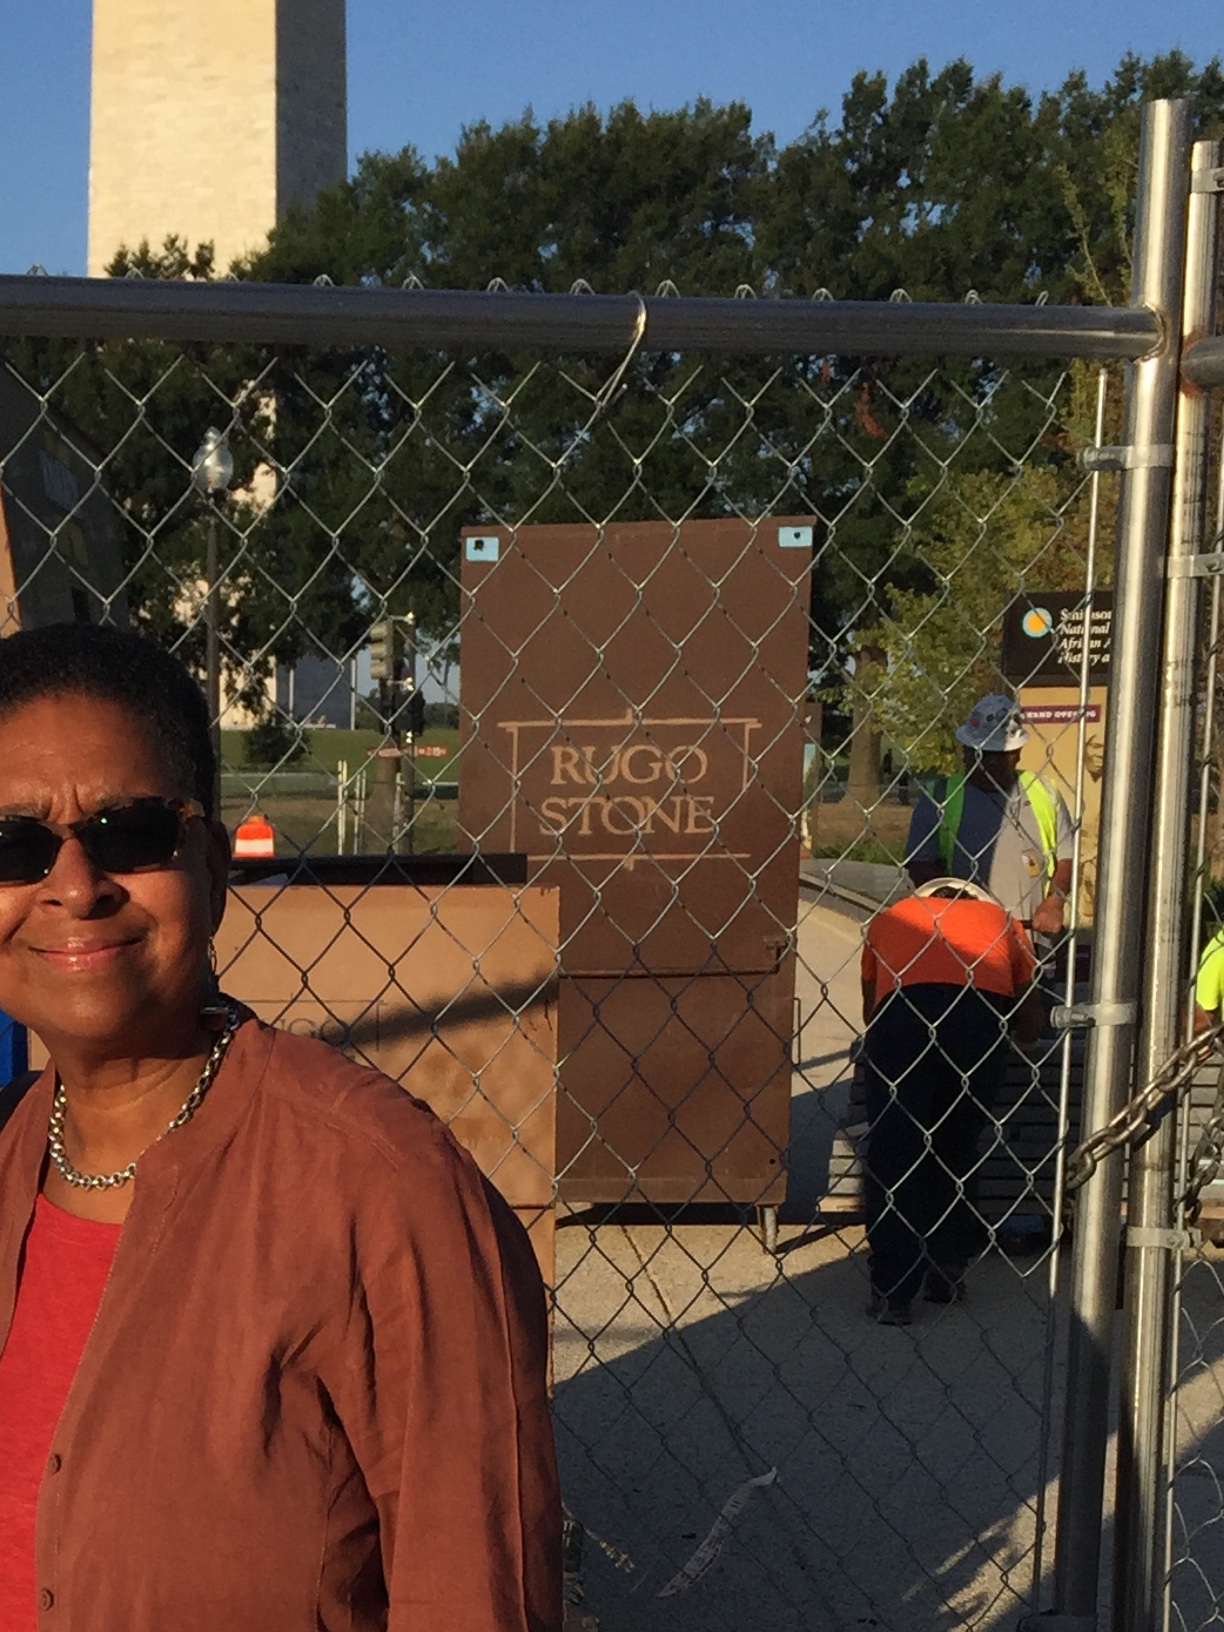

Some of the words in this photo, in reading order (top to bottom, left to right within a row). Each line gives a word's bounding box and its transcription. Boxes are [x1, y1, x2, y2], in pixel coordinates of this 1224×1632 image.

[1060, 622, 1110, 635] Natinal
[1057, 637, 1101, 651] Afrian
[549, 744, 708, 785] RUGO
[538, 795, 715, 836] STONE
